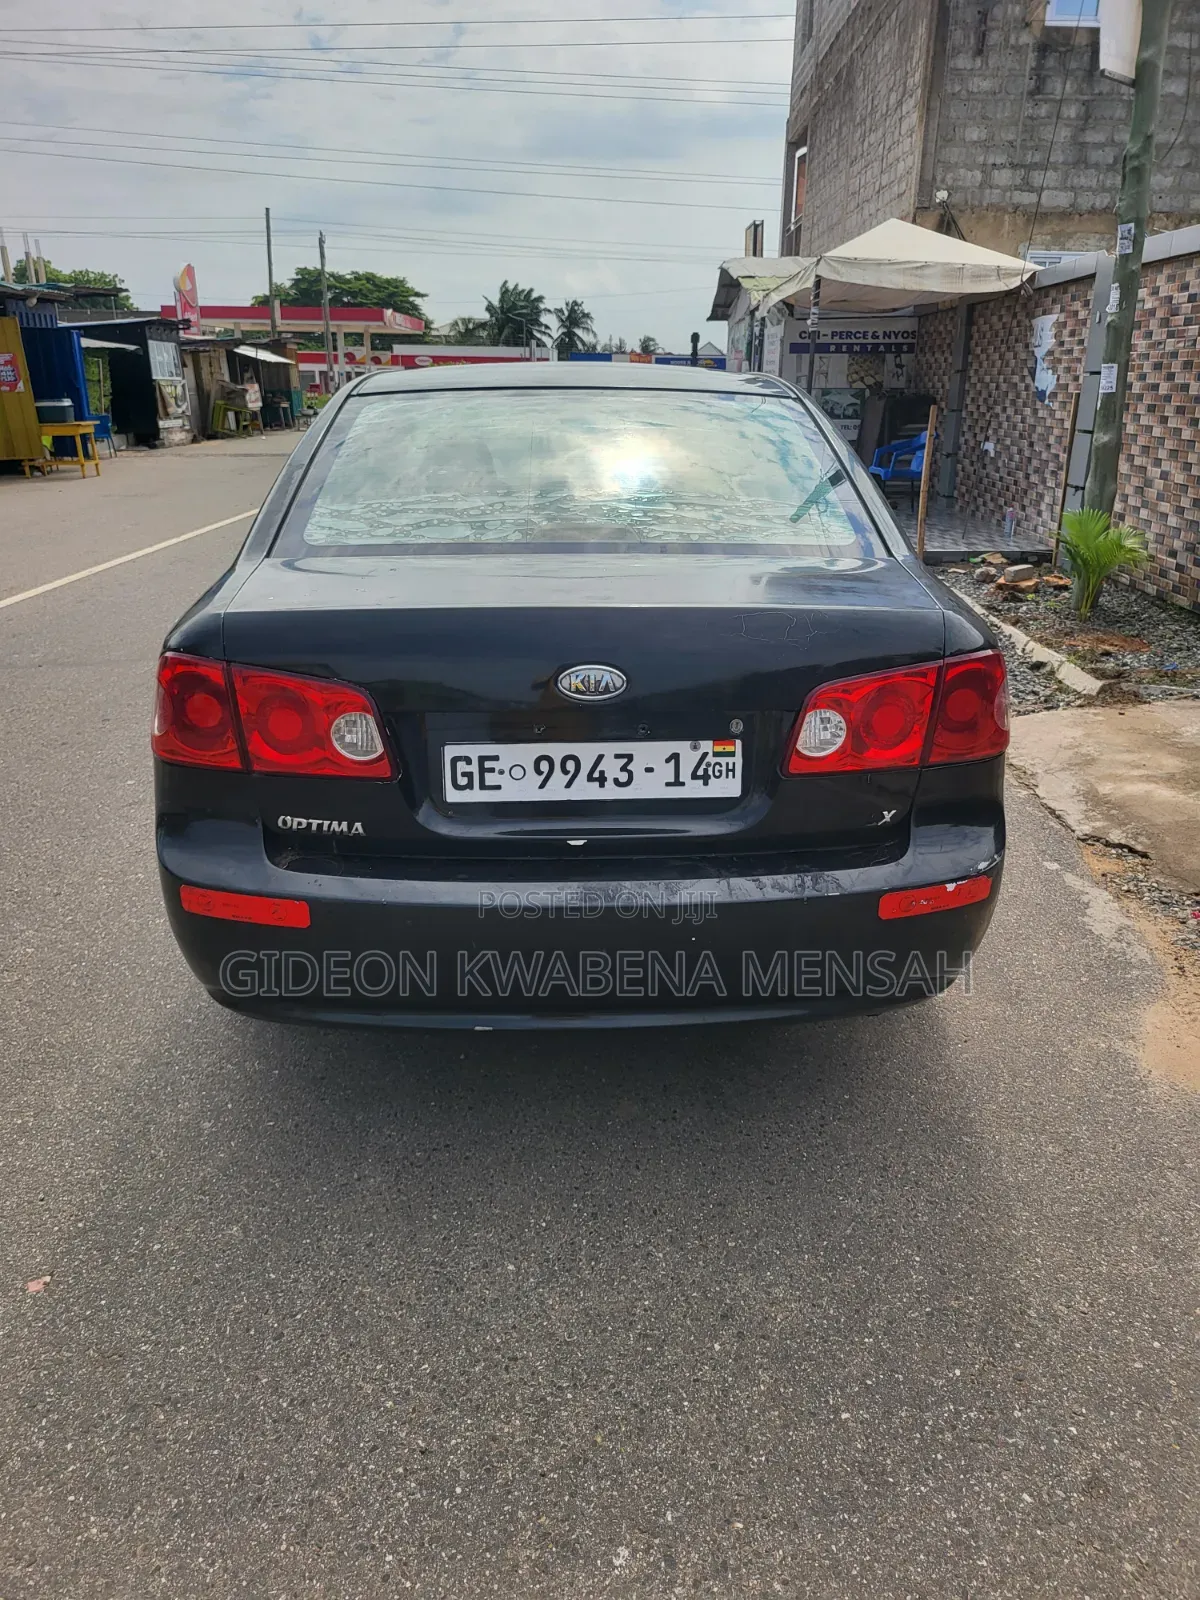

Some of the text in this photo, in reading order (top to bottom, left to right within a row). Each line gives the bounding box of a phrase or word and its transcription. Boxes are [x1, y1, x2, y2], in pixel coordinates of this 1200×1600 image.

[831, 330, 869, 340] PERCE
[870, 330, 880, 340] &
[829, 344, 909, 352] RENTALS
[569, 672, 616, 692] KIA
[450, 754, 502, 791] GE
[711, 761, 736, 780] GH
[277, 815, 366, 837] OPTIMA
[877, 809, 897, 826] X
